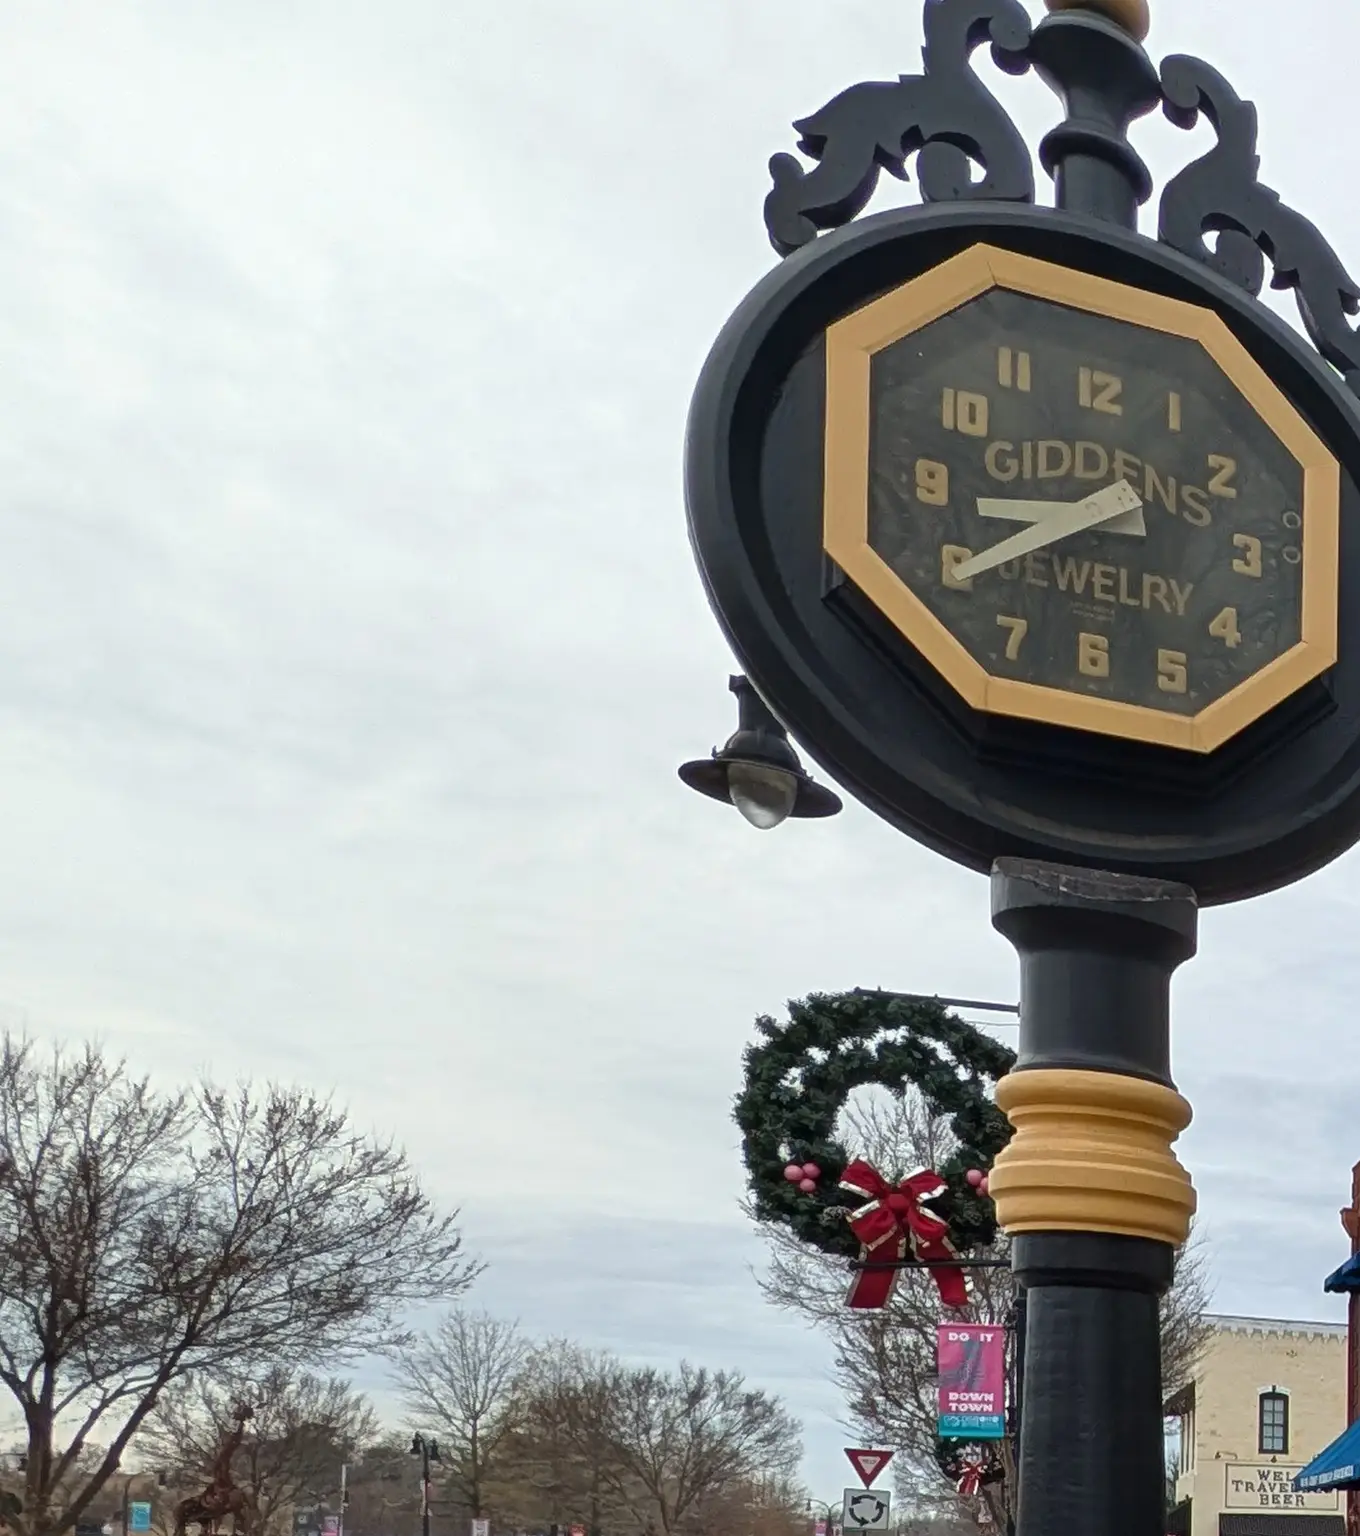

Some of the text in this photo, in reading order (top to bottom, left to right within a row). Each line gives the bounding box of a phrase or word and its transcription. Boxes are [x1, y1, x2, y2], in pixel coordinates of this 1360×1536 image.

[998, 346, 1031, 391] 11
[1078, 366, 1123, 416] 12
[942, 387, 989, 437] 10
[1169, 391, 1181, 432] 1
[915, 458, 949, 507] 9
[985, 440, 1213, 528] GIDDENS
[1207, 454, 1237, 499] 2
[941, 544, 974, 592] 8
[1232, 533, 1263, 578] 3
[999, 550, 1194, 616] JEWELRY
[996, 615, 1028, 660] 7
[1209, 607, 1241, 649] 4
[1079, 633, 1109, 678] 6
[1157, 649, 1187, 694] 5
[948, 1332, 994, 1342] DO IT
[948, 1392, 994, 1402] DOWN
[948, 1403, 994, 1412] TOWN
[1257, 1469, 1295, 1481] WEL
[1259, 1494, 1305, 1506] BEER
